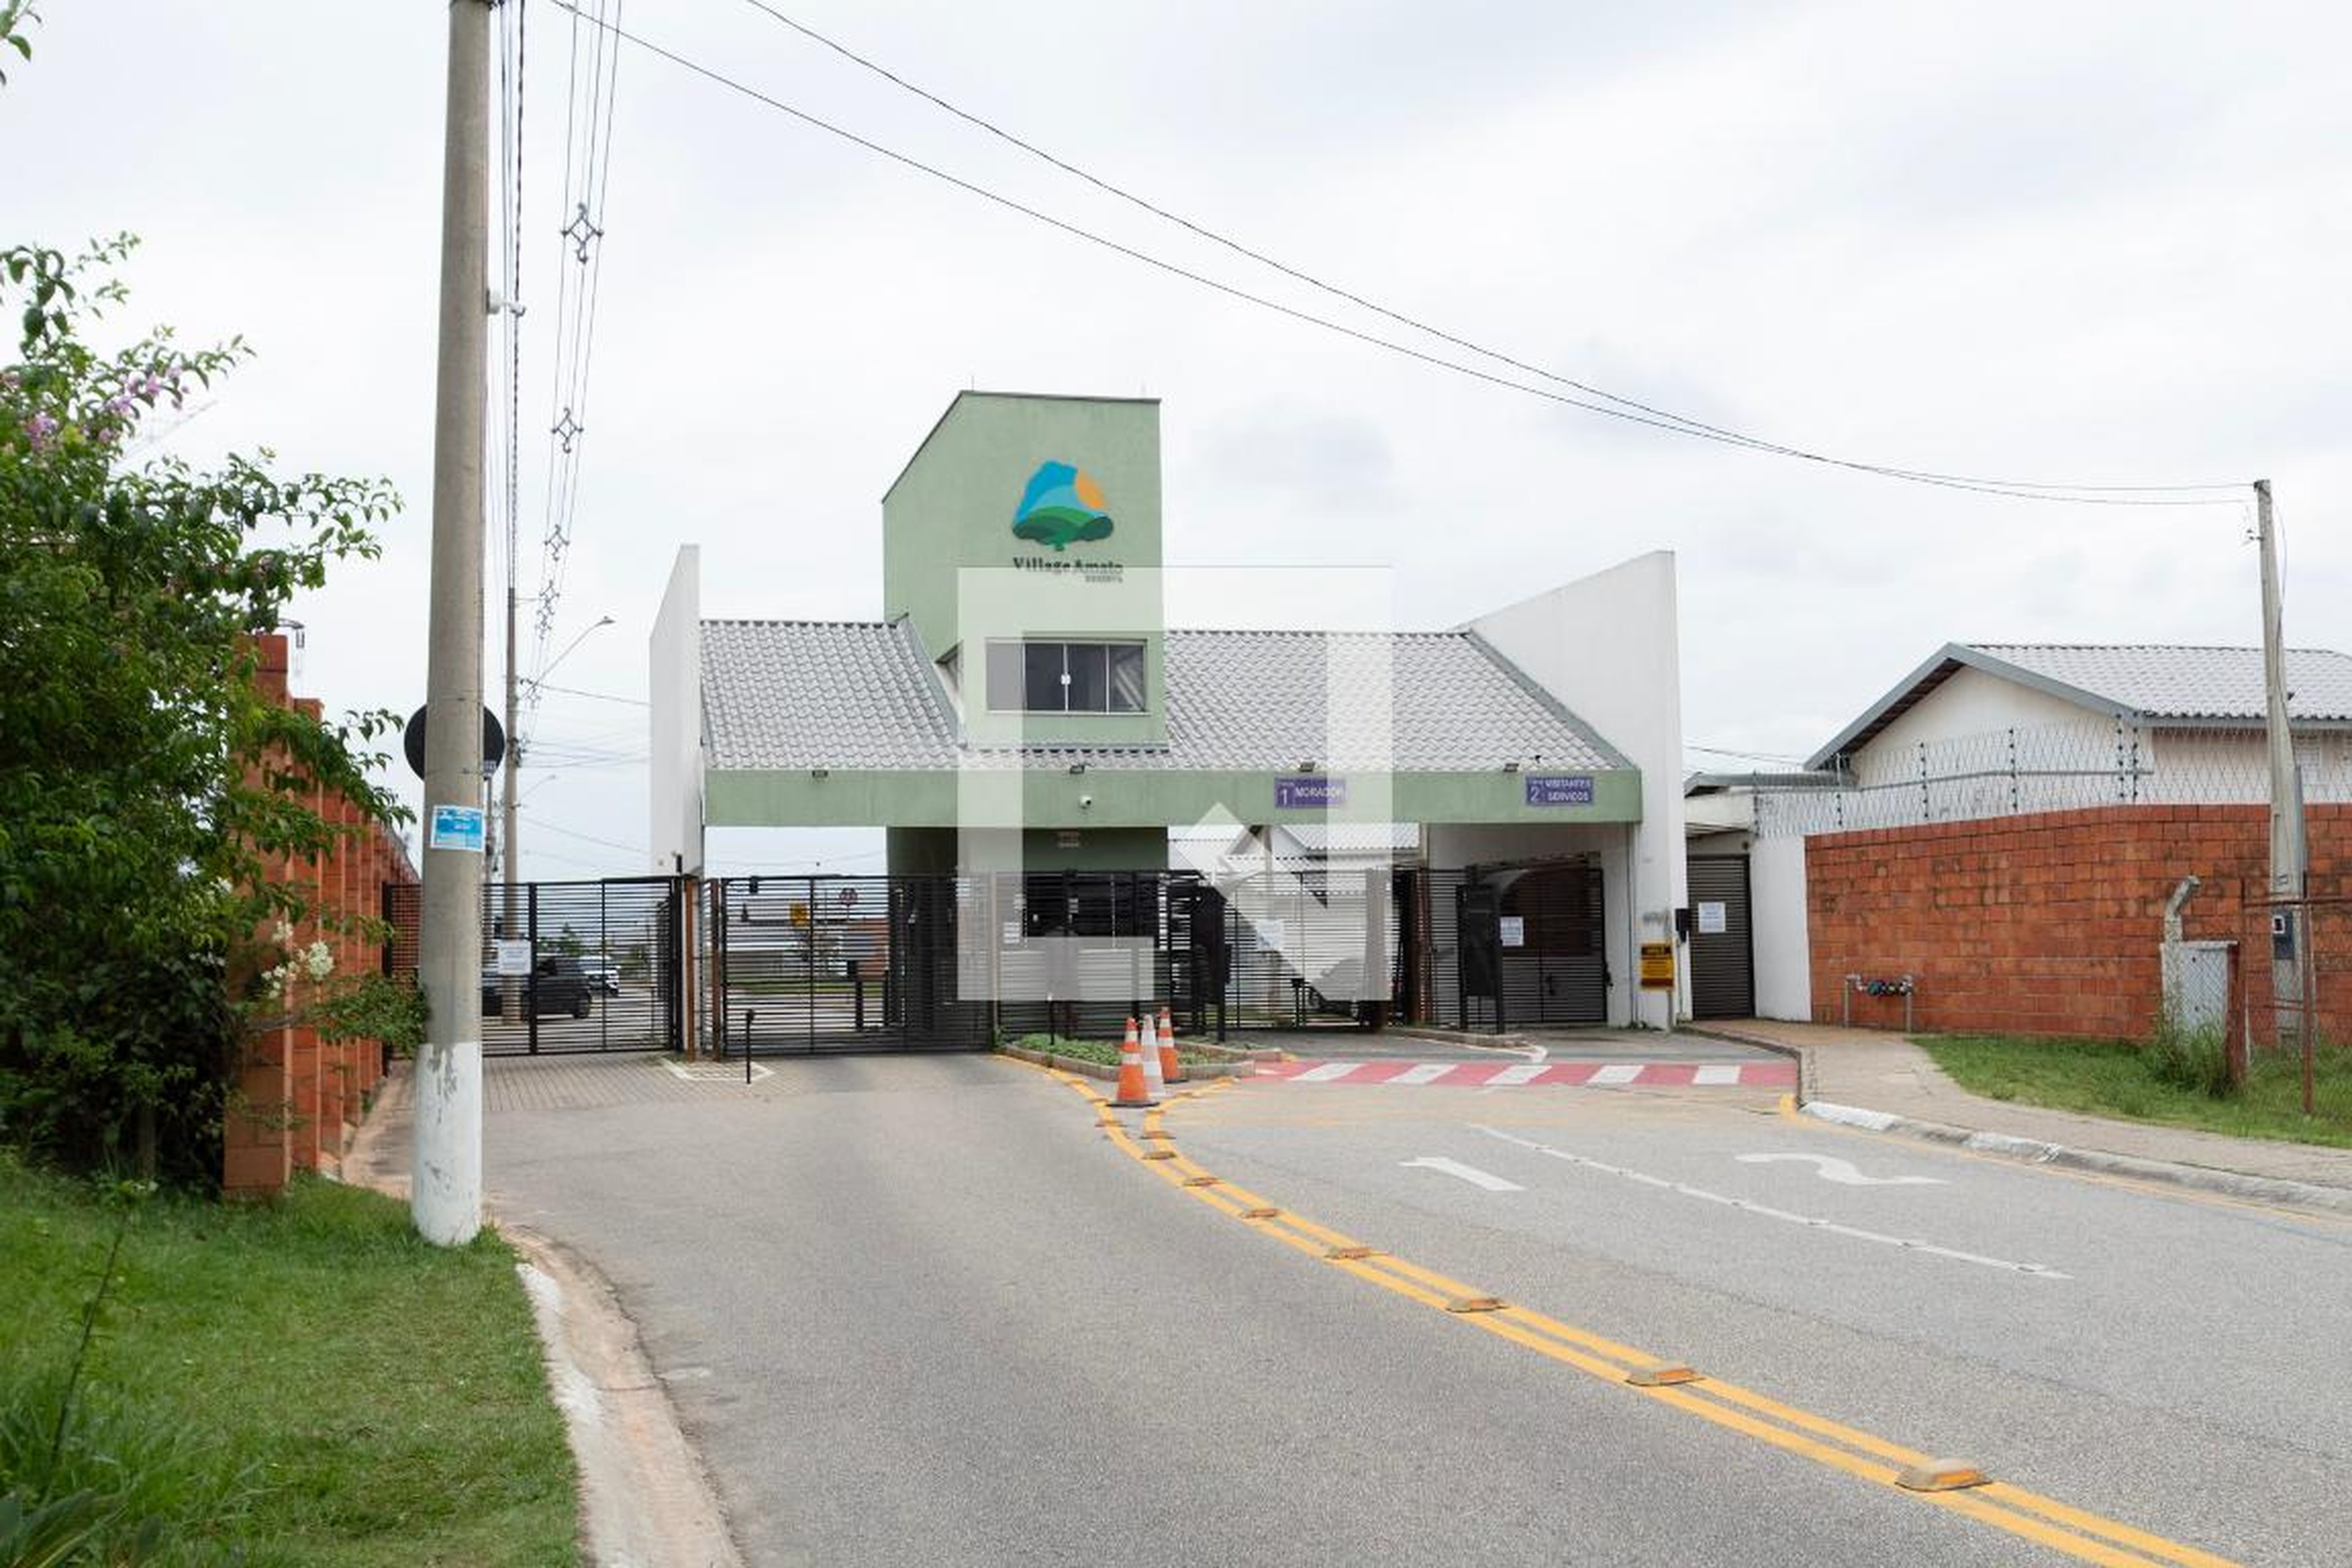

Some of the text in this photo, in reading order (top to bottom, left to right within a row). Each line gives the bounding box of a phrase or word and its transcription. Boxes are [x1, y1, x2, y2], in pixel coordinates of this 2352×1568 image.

[1014, 557, 1123, 575] Village Amato
[1280, 788, 1287, 805] 1
[1531, 786, 1540, 802] 2
